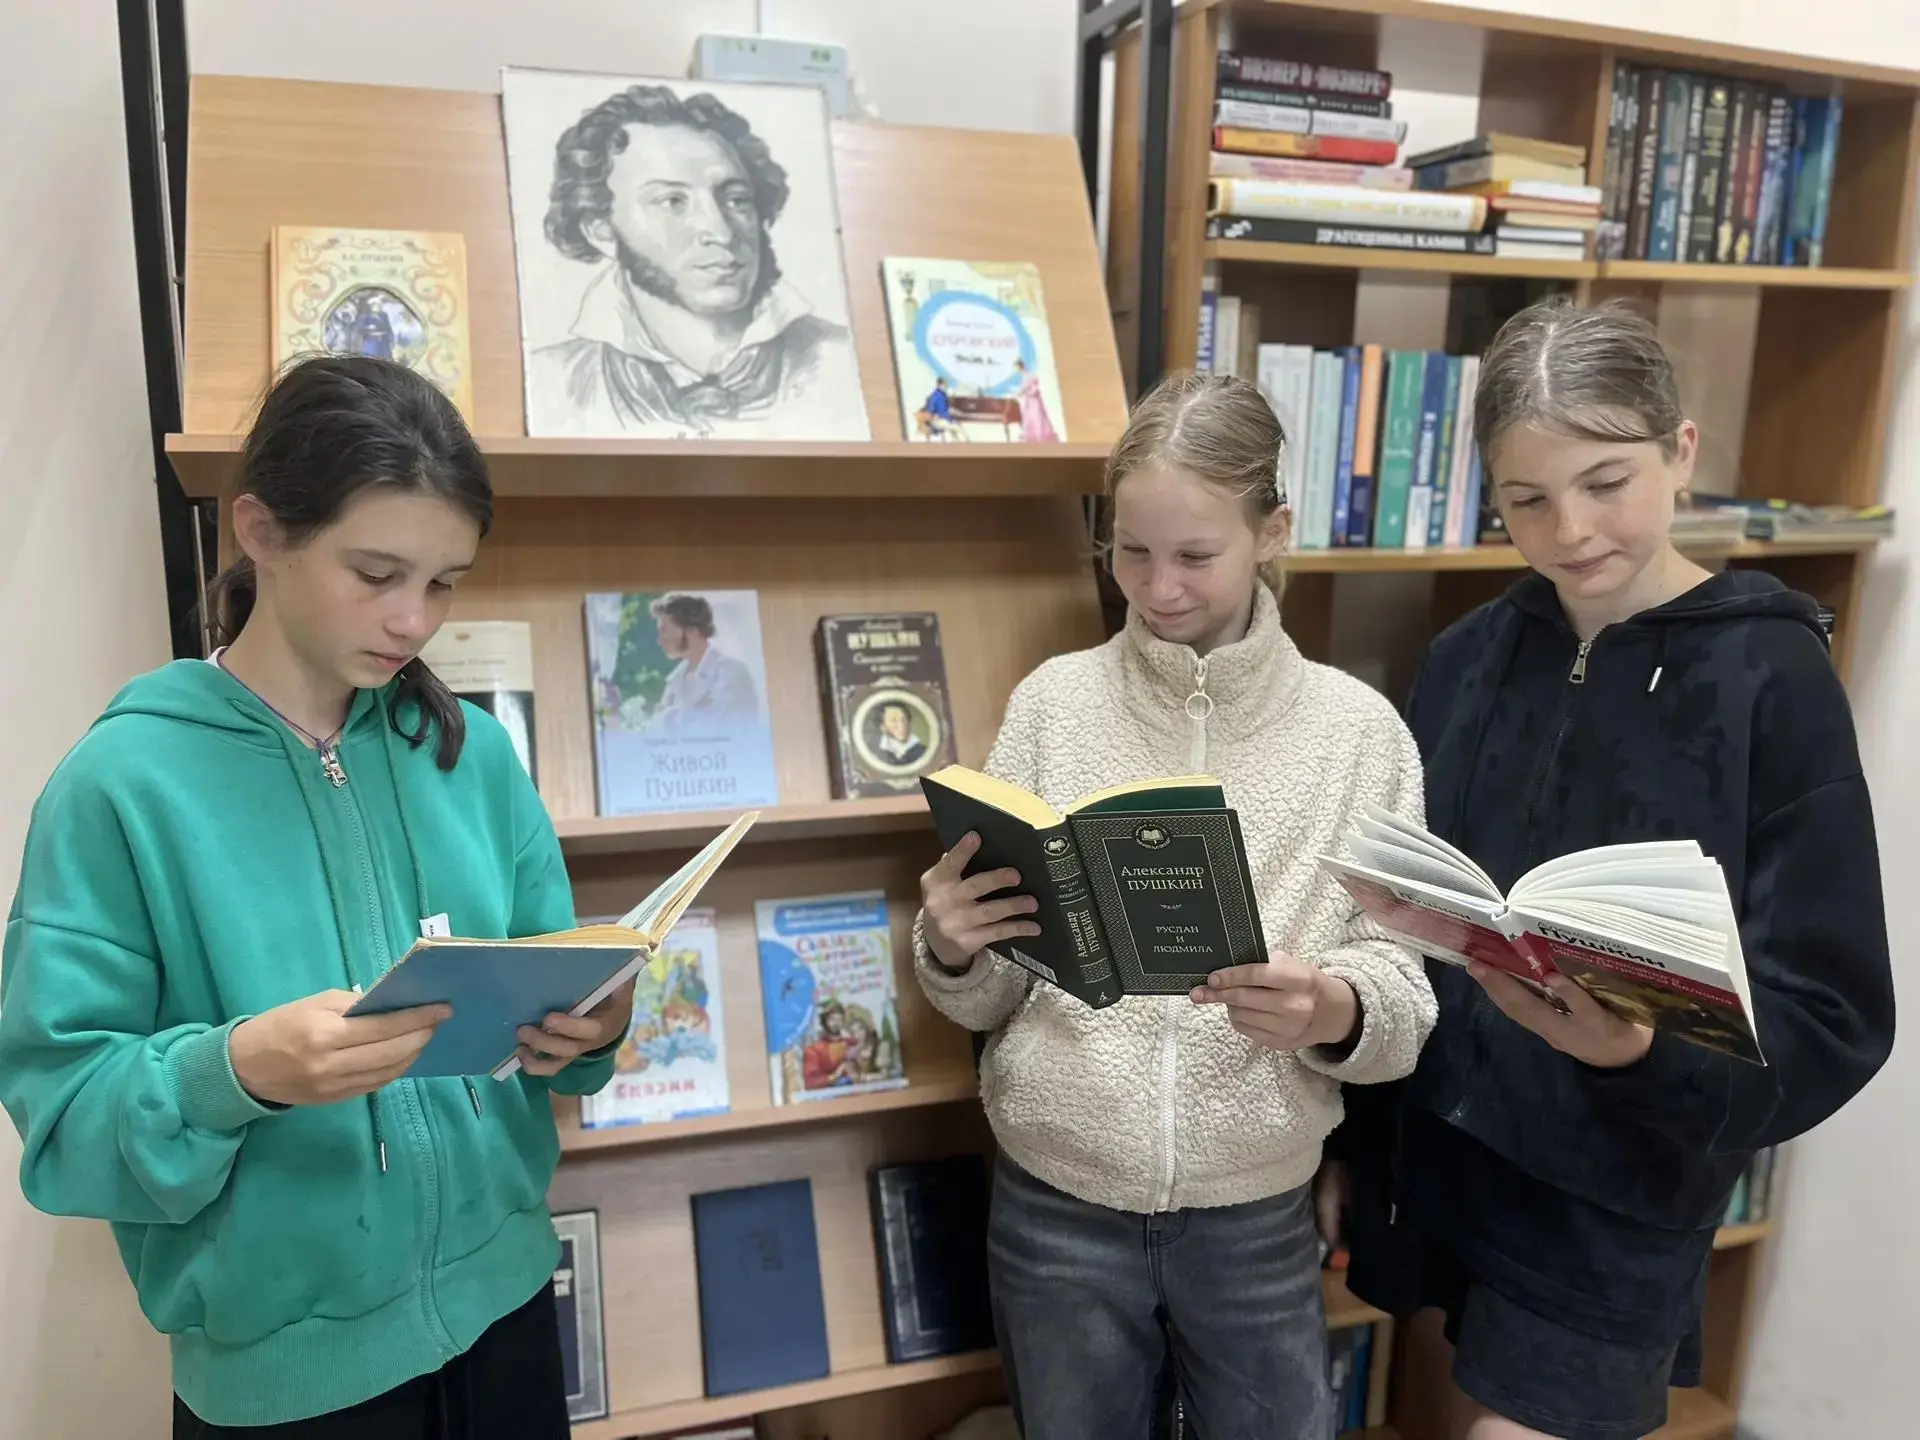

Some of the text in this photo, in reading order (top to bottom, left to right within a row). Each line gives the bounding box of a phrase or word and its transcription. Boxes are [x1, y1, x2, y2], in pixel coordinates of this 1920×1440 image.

[1121, 866, 1205, 877] Александр
[1127, 879, 1204, 890] ПУШКИН
[1067, 911, 1088, 958] Александр
[1079, 909, 1100, 953] ПУШКИН
[1153, 945, 1213, 953] ЛЮДМИЛА
[1538, 926, 1666, 969] Пушкин
